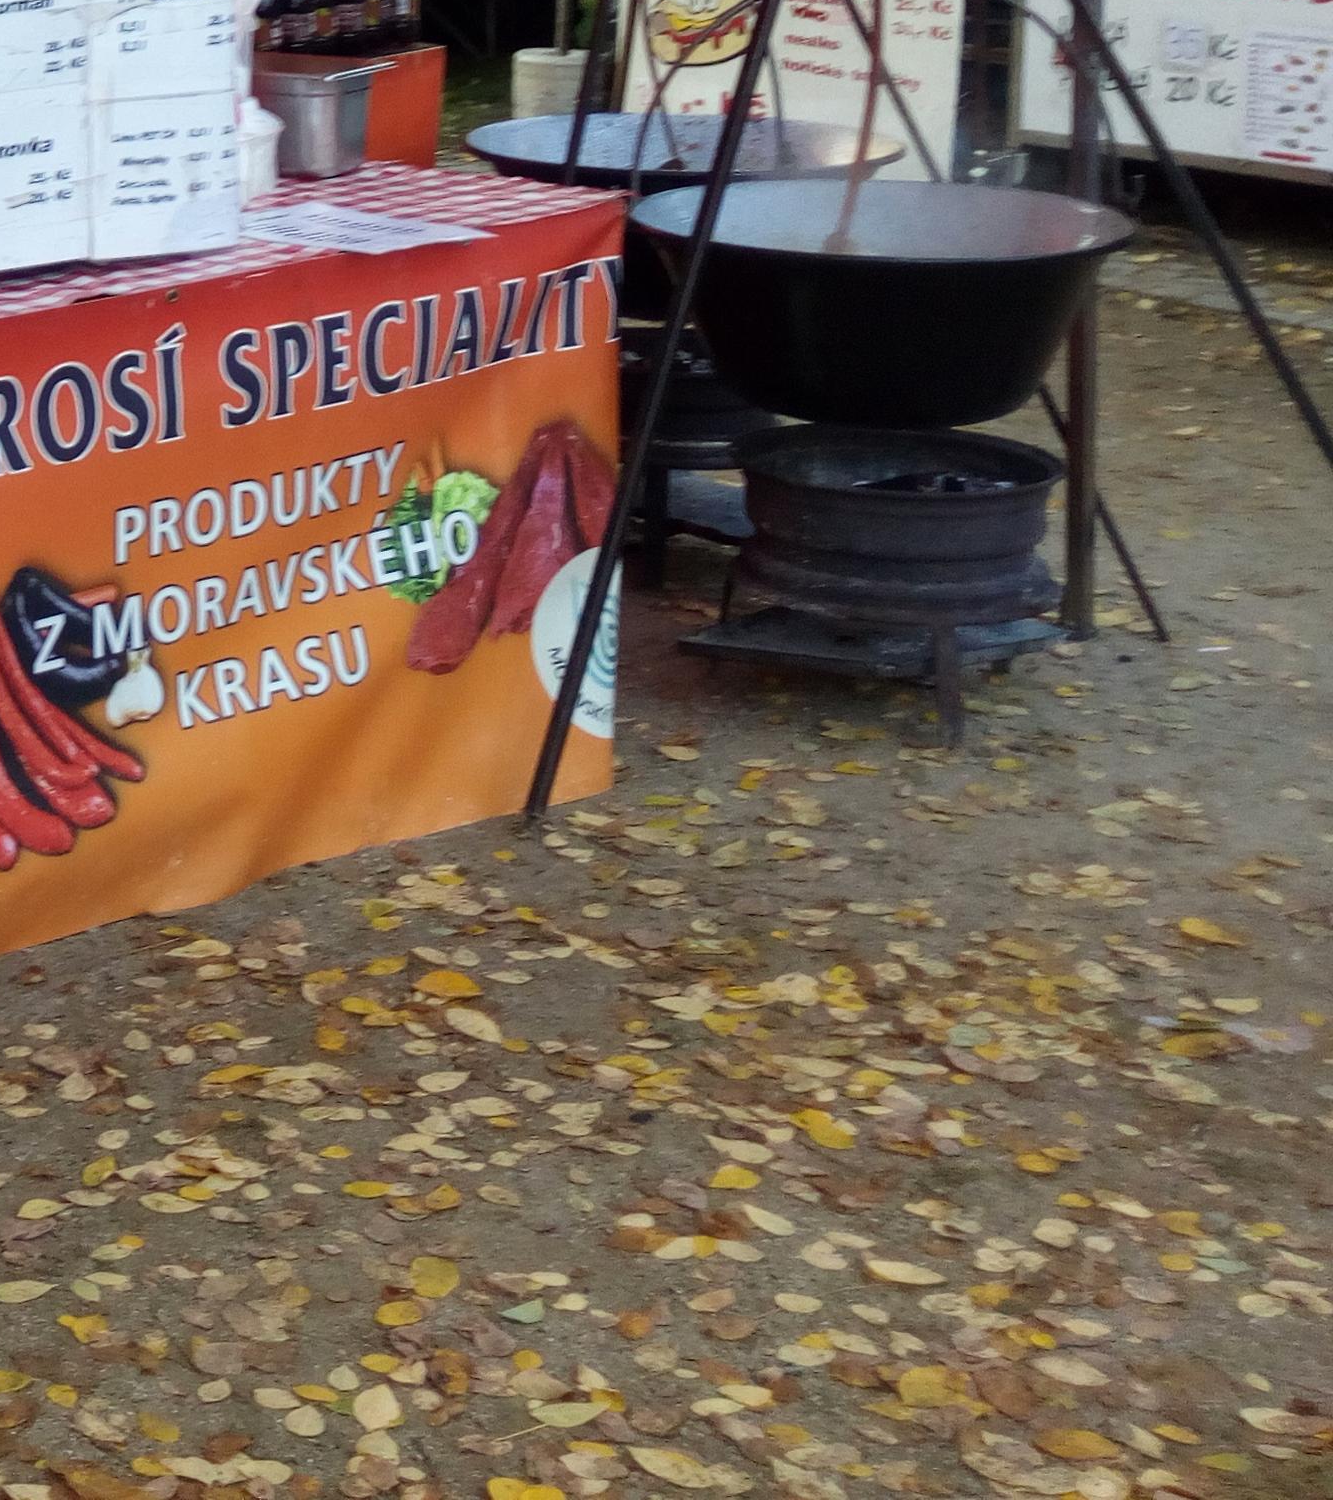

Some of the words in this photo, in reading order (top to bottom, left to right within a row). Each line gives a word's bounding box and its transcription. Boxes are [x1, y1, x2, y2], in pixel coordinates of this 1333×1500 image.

[218, 255, 622, 430] SPECIALITY
[113, 442, 407, 565] PRODUKTY
[33, 615, 68, 676] Z
[91, 501, 481, 660] MORAVSKÉHO
[176, 624, 372, 731] KRASU
